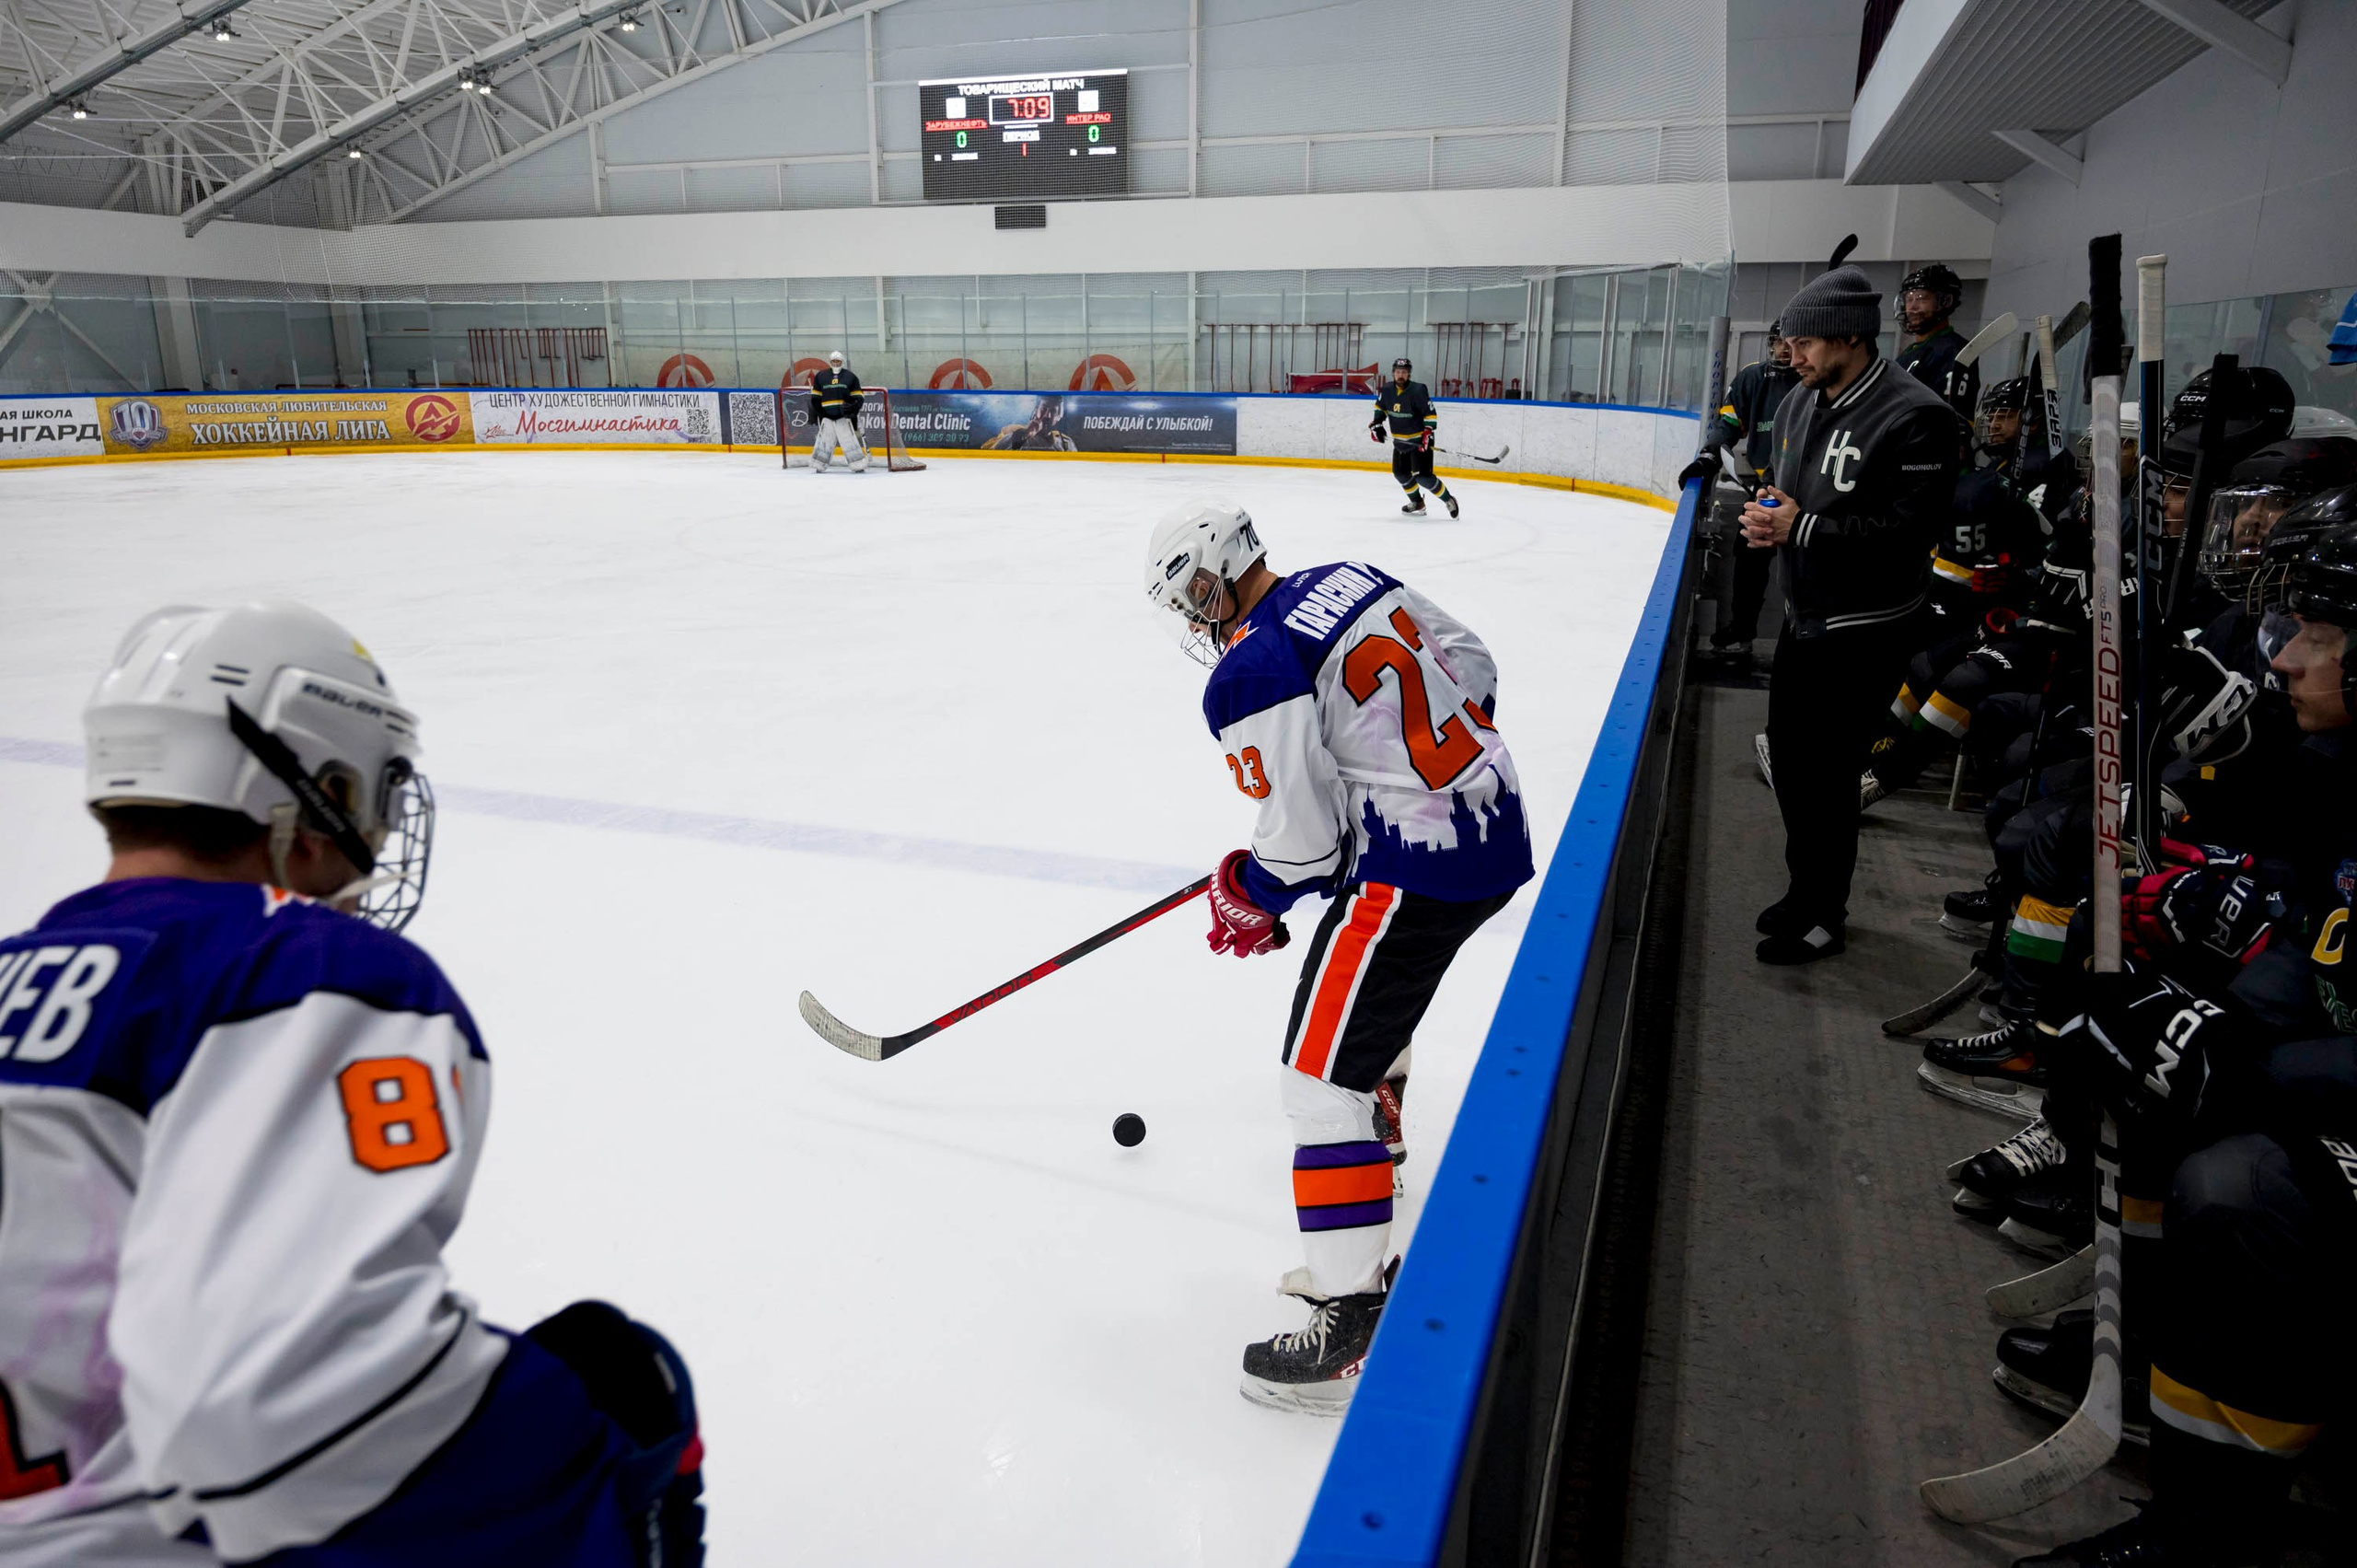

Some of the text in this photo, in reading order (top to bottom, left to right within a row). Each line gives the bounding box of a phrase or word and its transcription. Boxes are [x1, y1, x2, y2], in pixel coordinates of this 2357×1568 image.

[958, 79, 1085, 96] ТОВАРИЩЕСКИЙ МАТЧ
[1007, 97, 1051, 118] 7:09
[957, 131, 967, 148] 0
[1088, 125, 1099, 142] 0
[186, 401, 387, 414] МОСКОВСКАЯ ЛЮБИТЕЛЬСКАЯ
[490, 392, 700, 408] ЦЕНТР ХУДОЖЕСТВЕННОЙ ГИМНАСТИКИ
[2179, 394, 2207, 402] CCM
[22, 409, 74, 420] ШКОЛА
[516, 410, 682, 436] Мосгимнастика
[890, 413, 931, 429] Dental
[934, 413, 971, 430] Clinic
[1084, 414, 1213, 432] ПОБЕЖДАЙ С УЛЫБКОЙ!
[190, 416, 391, 445] ХОККЕЙНАЯ ЛИГА
[1820, 429, 1861, 493] HC
[1901, 463, 1942, 471] BOGOMOLOV
[2144, 468, 2164, 572] CCM
[1956, 523, 1987, 552] 55
[1167, 553, 1190, 580] BAUER
[1283, 566, 1377, 641] ТАРАСКИН
[2099, 586, 2107, 609] PRO
[2098, 647, 2120, 870] JETSPEED
[1225, 746, 1271, 799] 23
[948, 970, 1033, 1022] VAPOR
[1382, 1089, 1399, 1114] CCM
[337, 1056, 462, 1174] 8
